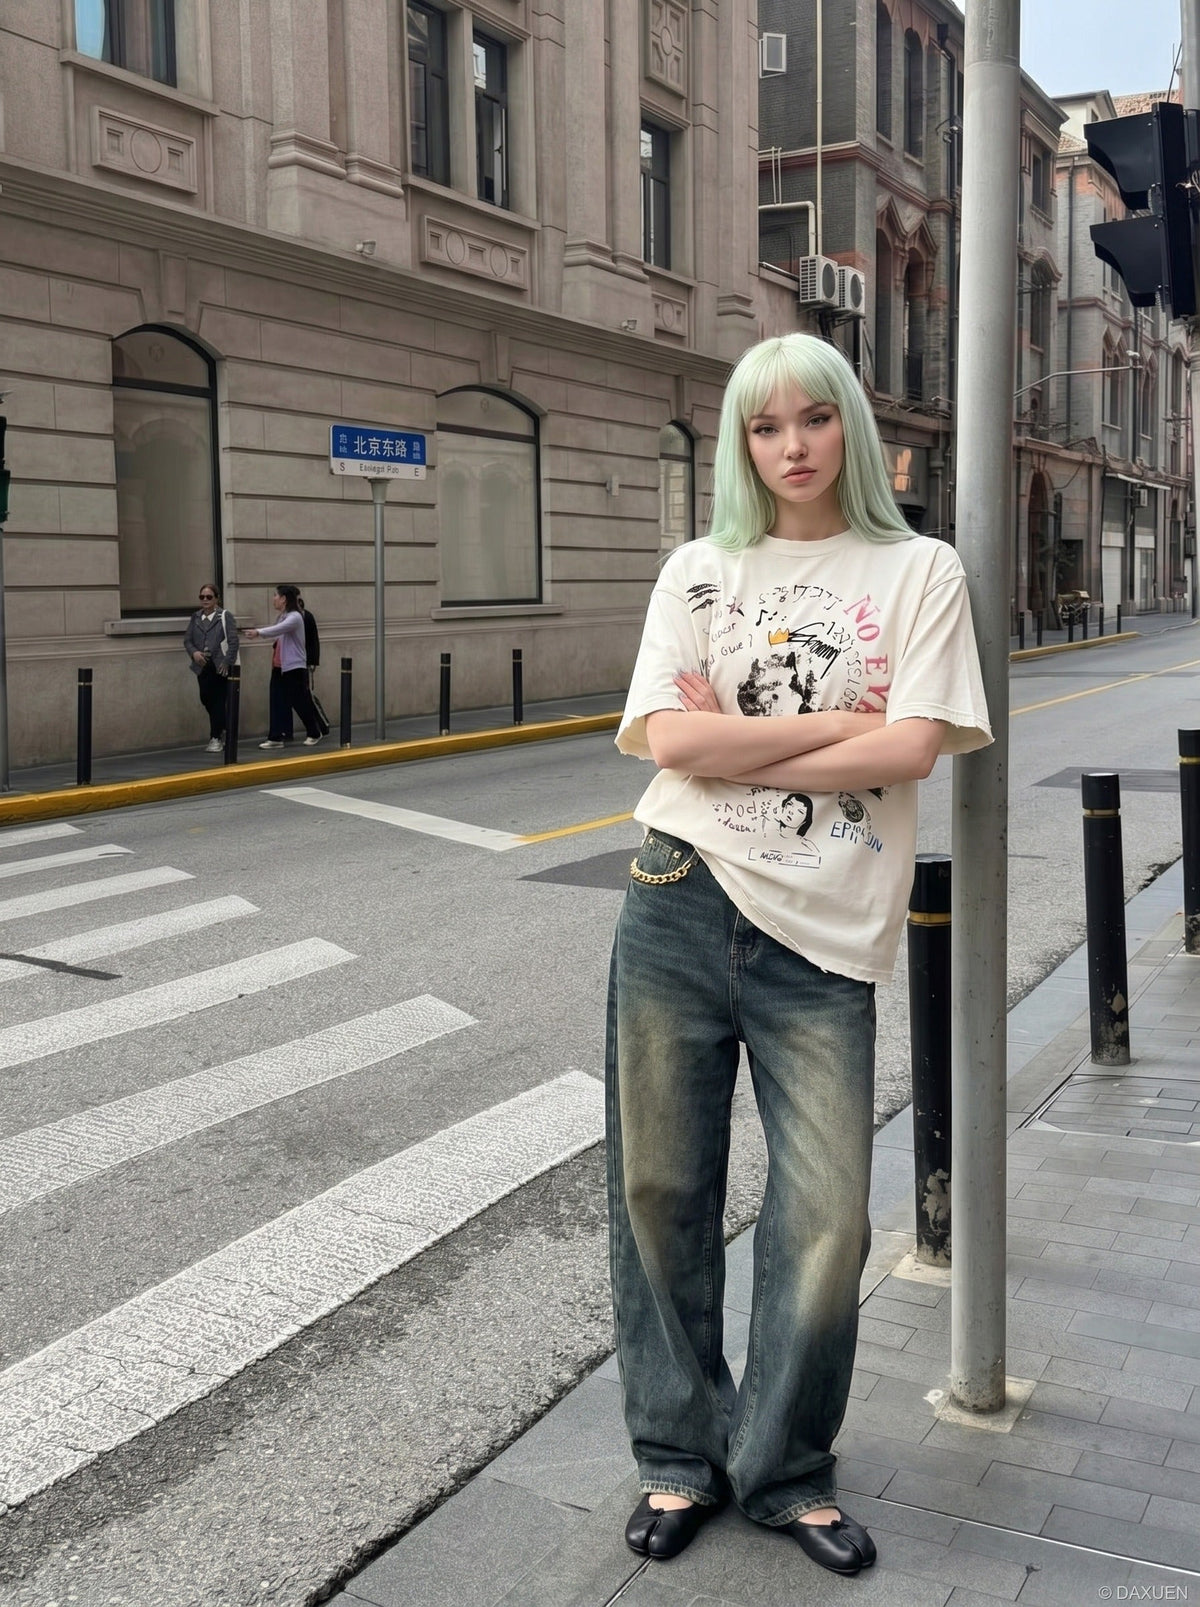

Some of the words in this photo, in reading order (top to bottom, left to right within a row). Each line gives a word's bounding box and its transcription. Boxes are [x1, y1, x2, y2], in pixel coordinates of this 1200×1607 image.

[353, 435, 408, 458] 北京东路
[340, 462, 346, 471] S
[414, 467, 419, 477] E
[843, 594, 881, 642] NO
